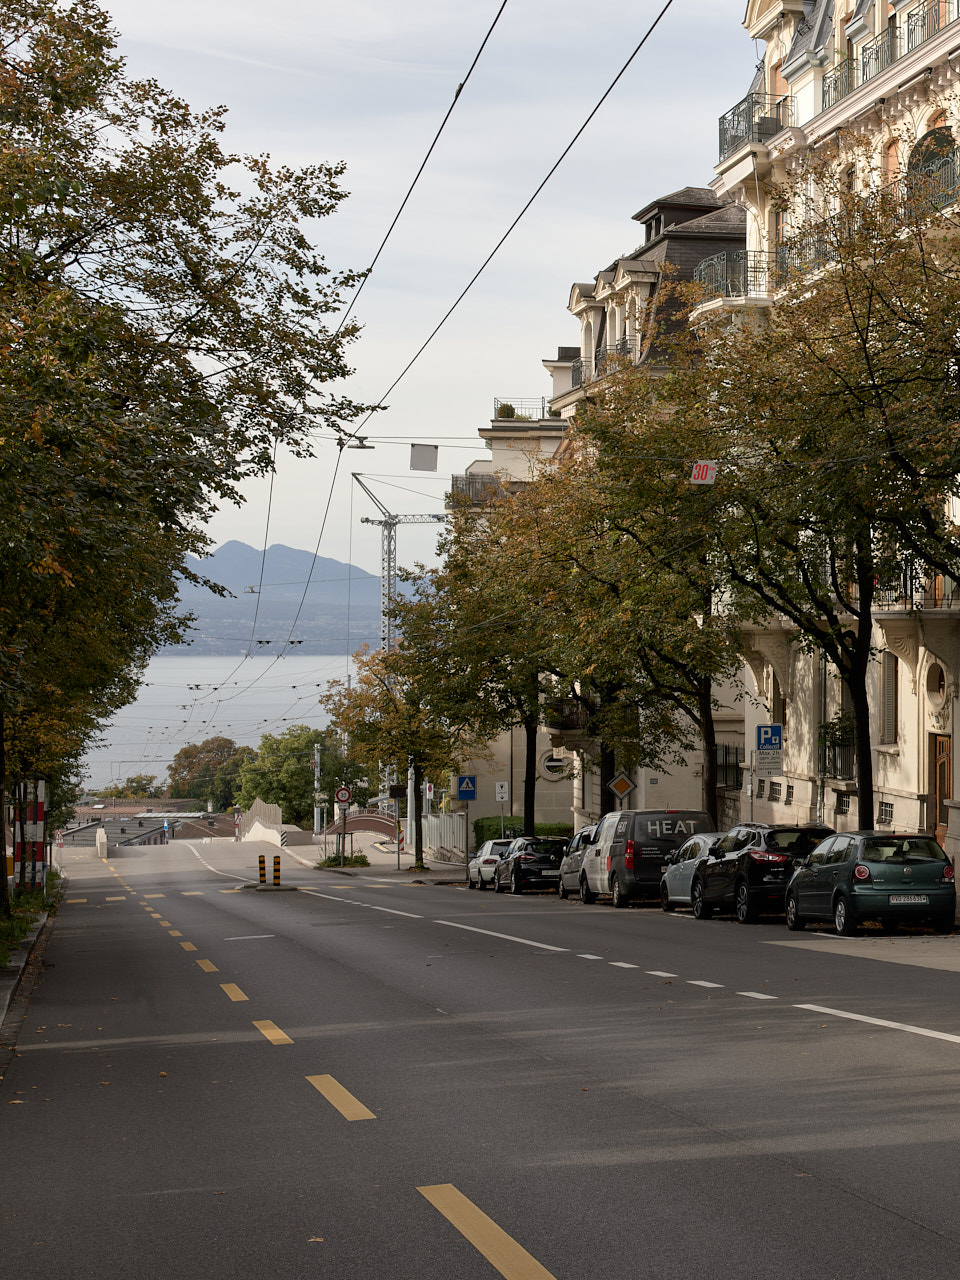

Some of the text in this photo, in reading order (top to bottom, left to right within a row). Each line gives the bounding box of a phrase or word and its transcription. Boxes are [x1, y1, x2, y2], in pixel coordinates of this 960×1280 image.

[693, 464, 709, 480] 30
[760, 727, 772, 744] P
[648, 820, 697, 837] HEAT
